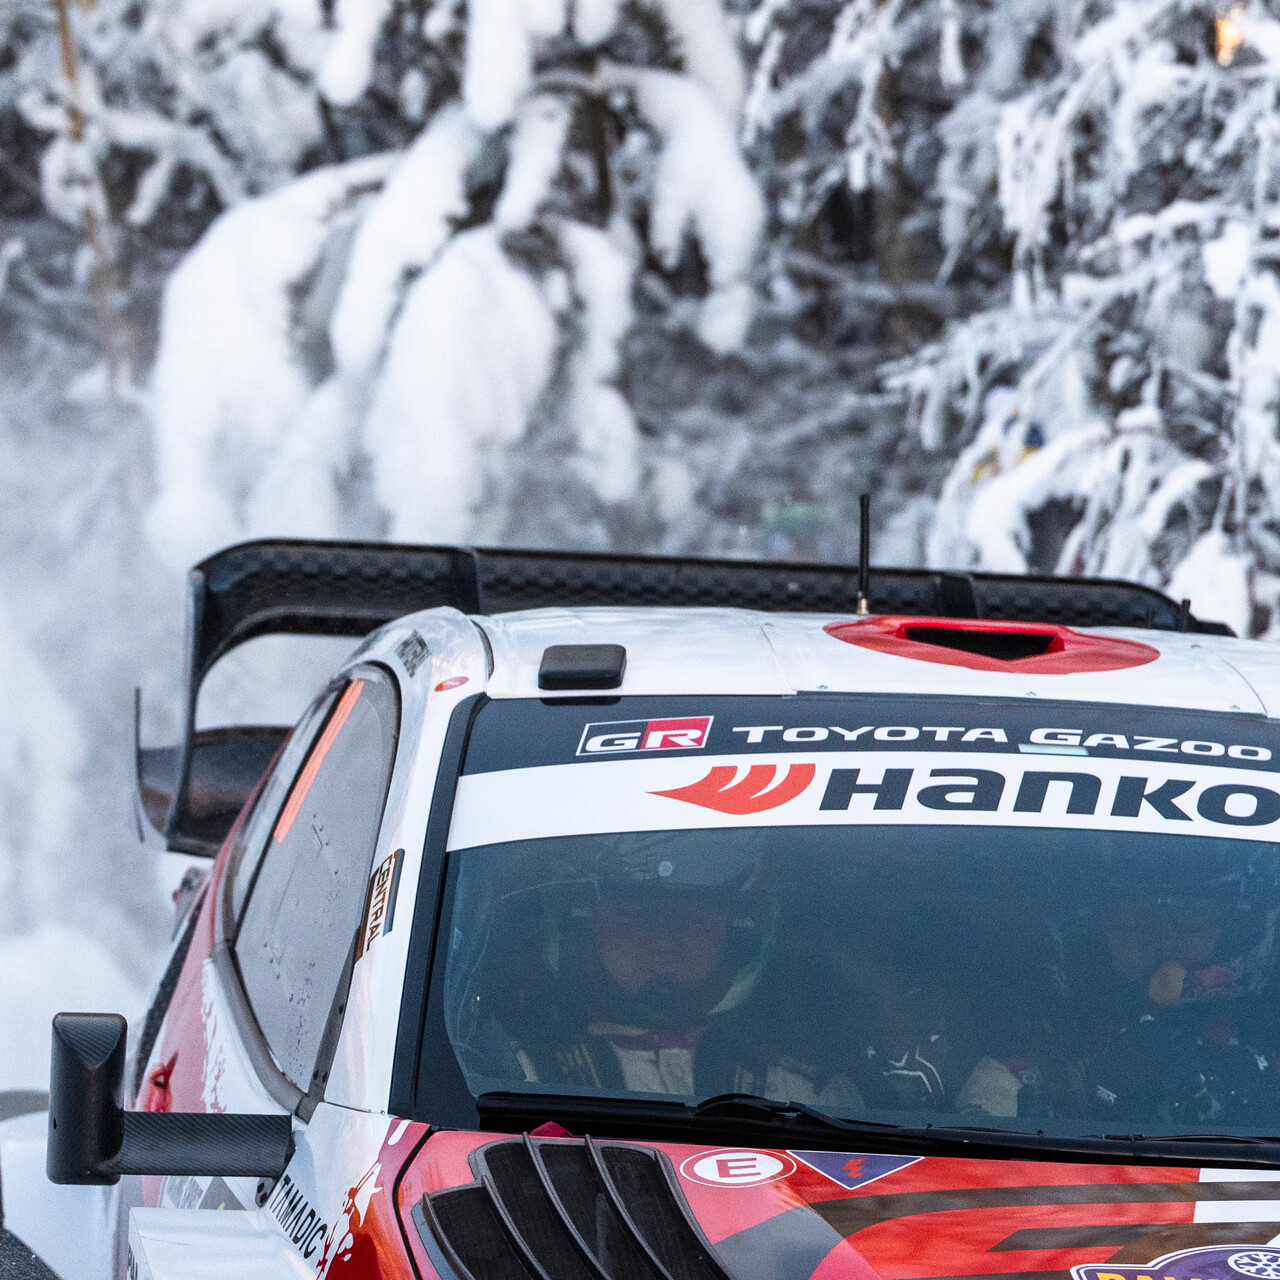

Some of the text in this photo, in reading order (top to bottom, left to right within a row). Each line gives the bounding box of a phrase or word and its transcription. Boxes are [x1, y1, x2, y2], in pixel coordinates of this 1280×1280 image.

[585, 728, 706, 754] GR
[732, 724, 1009, 744] TOYOTA
[1029, 727, 1273, 762] GAZOO
[366, 853, 394, 953] CENTRAL
[269, 1173, 328, 1260] TAMADIC
